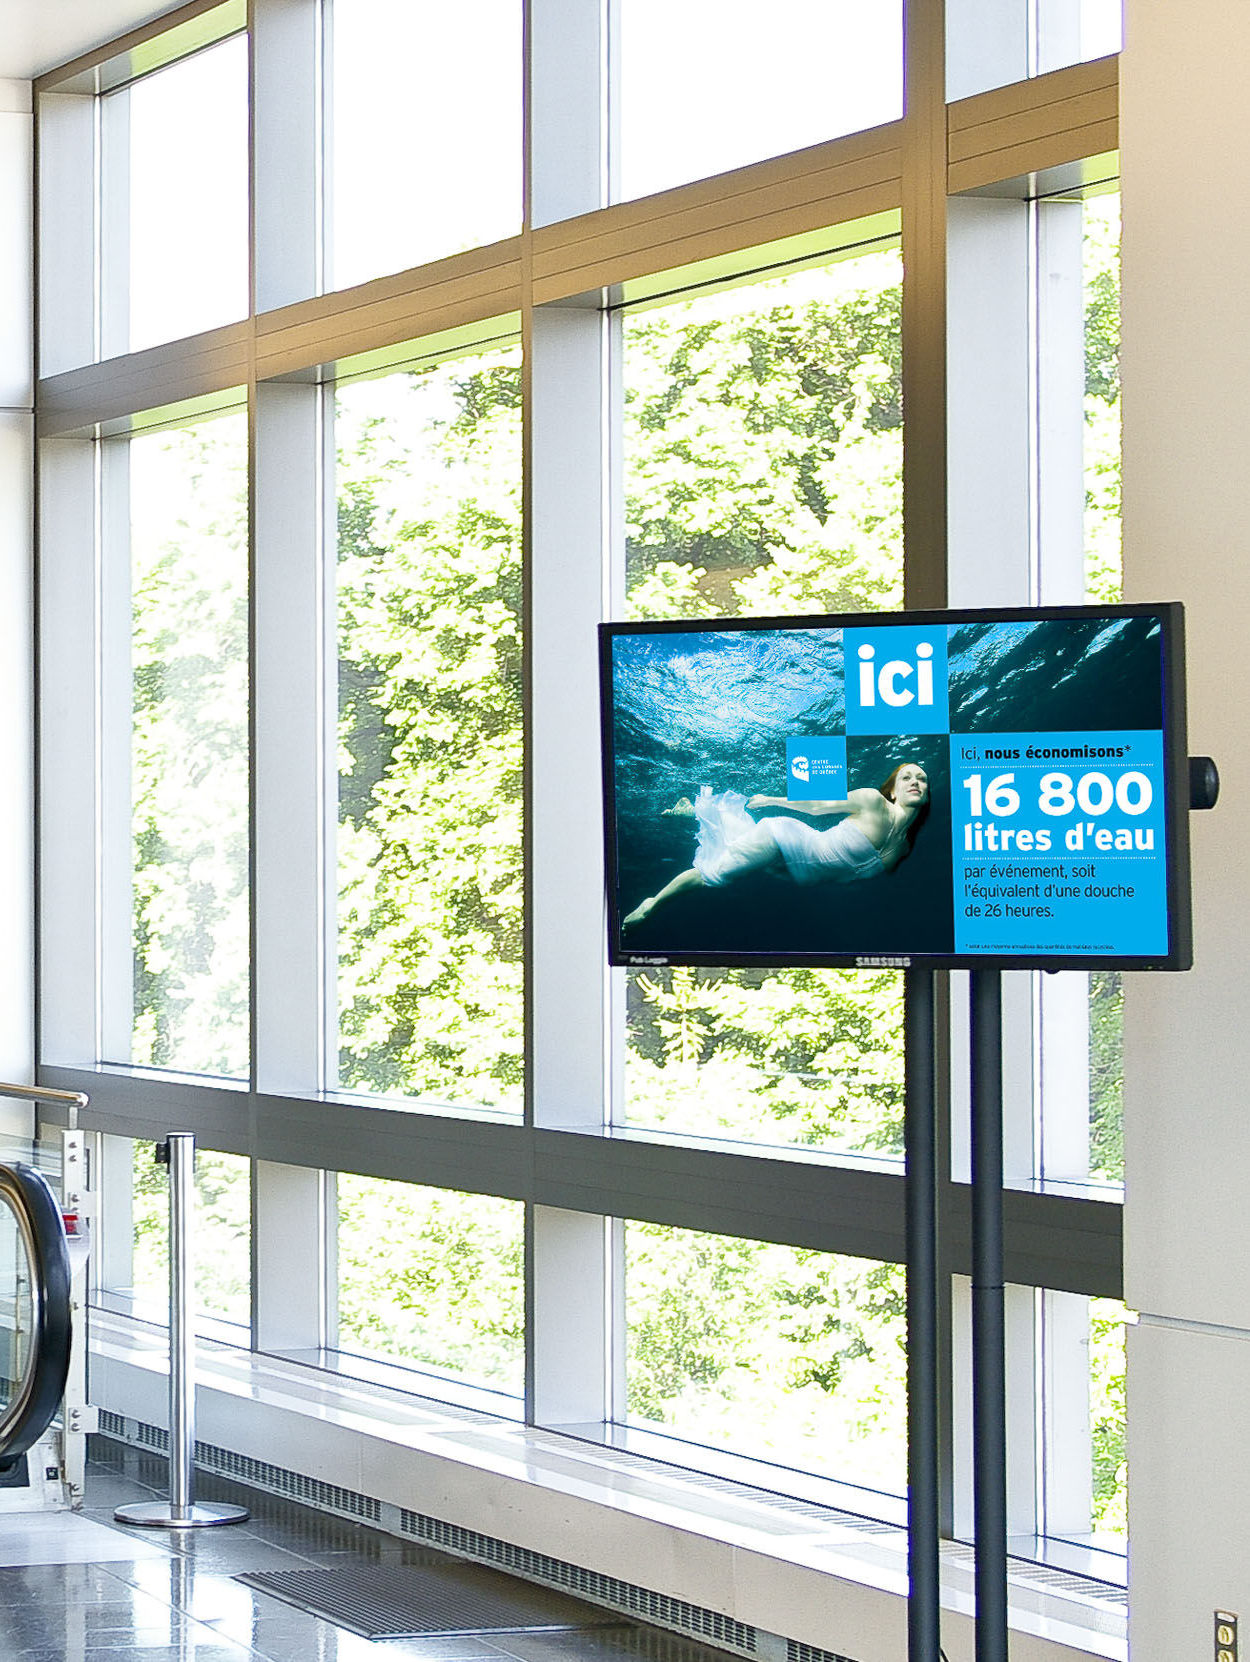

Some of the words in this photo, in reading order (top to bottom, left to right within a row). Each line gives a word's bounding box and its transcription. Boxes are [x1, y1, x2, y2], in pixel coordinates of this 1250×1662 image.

[857, 642, 934, 708] ici
[961, 747, 980, 761] Ici,
[985, 748, 1020, 759] nous
[962, 773, 1021, 817] 16
[1038, 771, 1153, 816] 800
[964, 822, 1052, 851] litres
[1065, 822, 1155, 851] d'eau
[964, 866, 985, 880] par
[989, 864, 1068, 880] événement,
[1071, 864, 1096, 878] soit
[964, 884, 1040, 900] l'équivalent
[1043, 884, 1081, 898] d'une
[1084, 883, 1135, 898] douche
[964, 903, 981, 917] de
[984, 903, 1002, 917] 26
[1005, 903, 1055, 917] heures.
[855, 956, 911, 967] SAMSUNG
